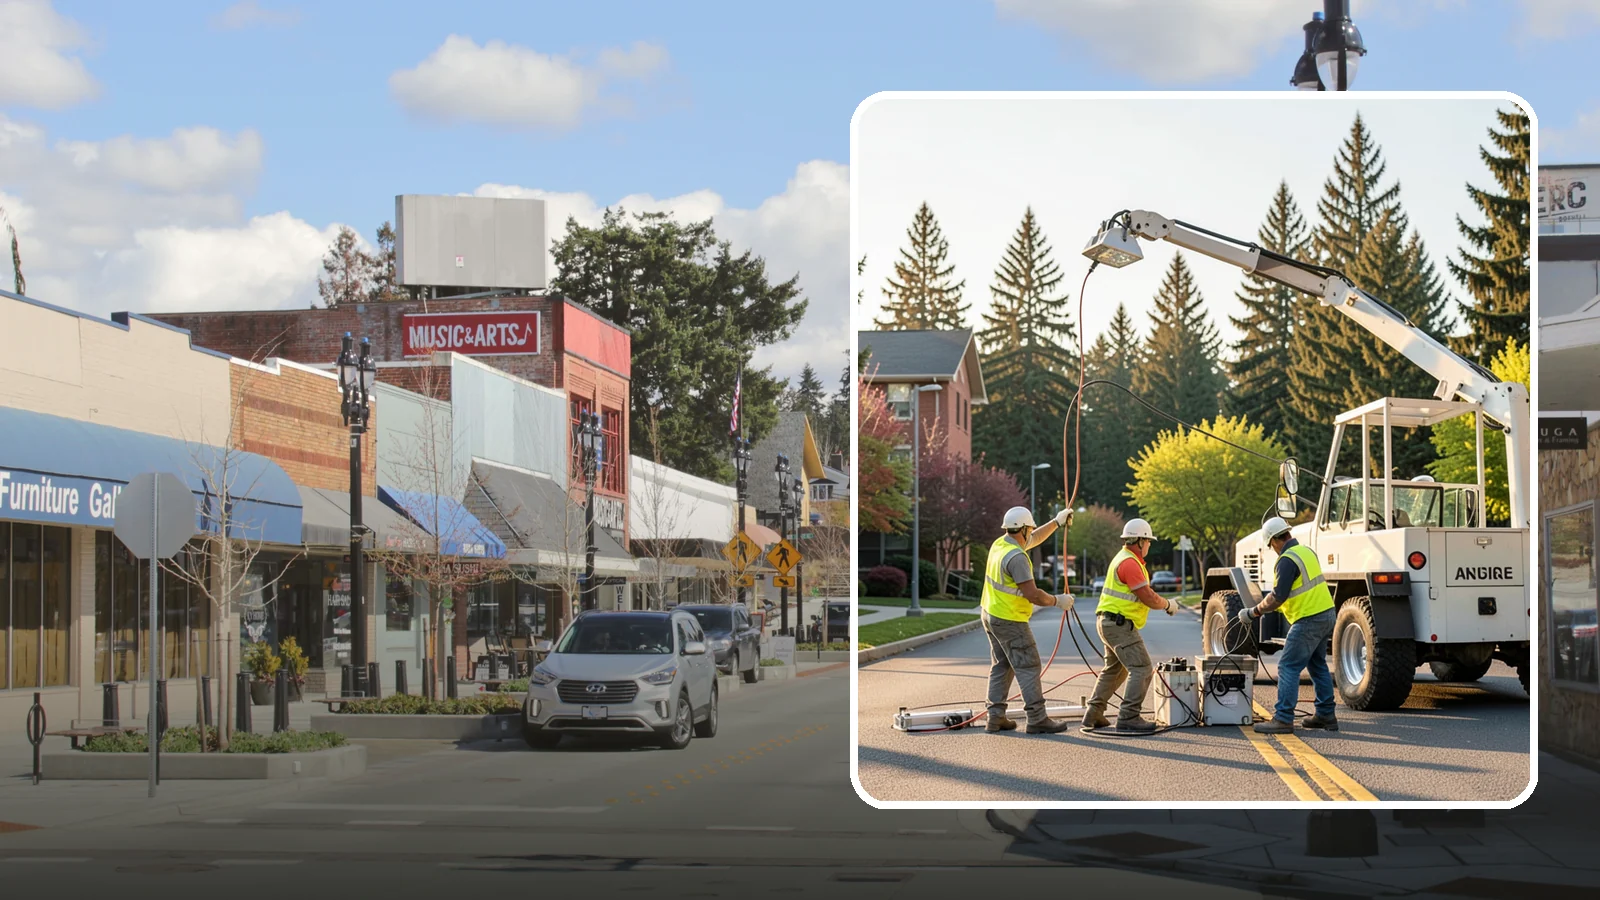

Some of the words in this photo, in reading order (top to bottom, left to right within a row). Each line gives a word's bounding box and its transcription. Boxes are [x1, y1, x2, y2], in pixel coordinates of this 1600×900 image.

[0, 471, 79, 515] Furniture
[89, 482, 122, 519] Gal
[454, 564, 480, 574] SUSHI
